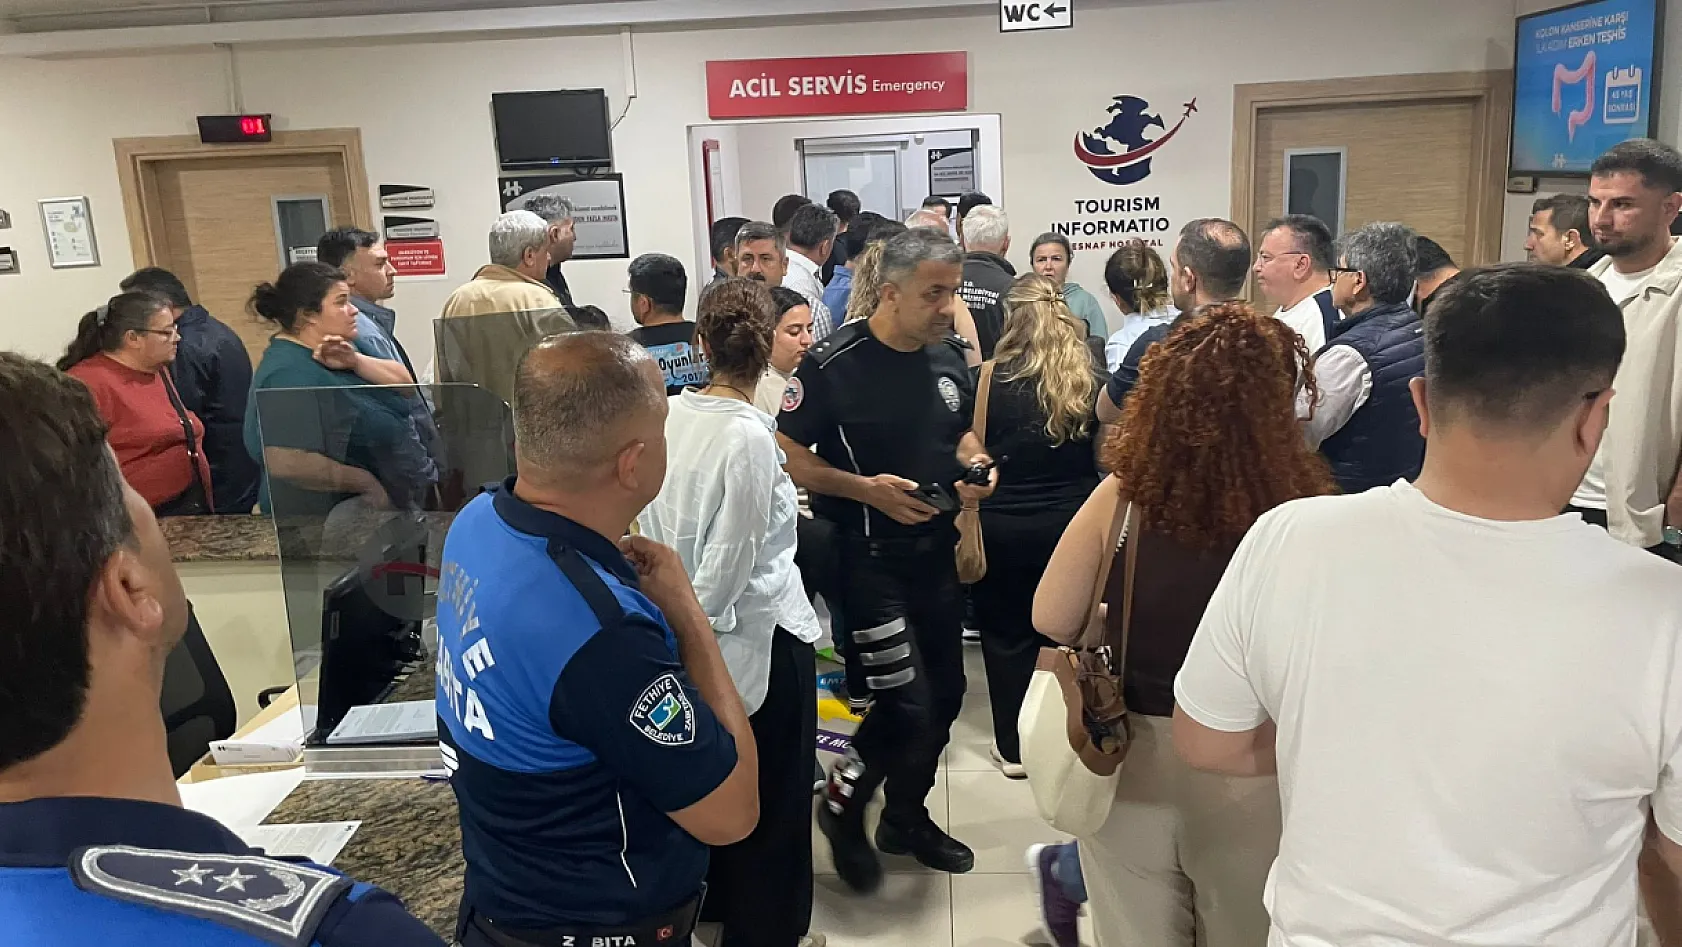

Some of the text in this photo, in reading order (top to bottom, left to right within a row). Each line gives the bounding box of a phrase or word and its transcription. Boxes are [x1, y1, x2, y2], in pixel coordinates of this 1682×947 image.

[1004, 3, 1040, 22] WC
[1568, 33, 1596, 48] ERKEN
[1596, 25, 1626, 44] TEŞHİS
[729, 69, 946, 98] ACİL SERVİS Emergency
[1074, 196, 1160, 214] TOURISM
[1051, 217, 1170, 236] INFORMATIO
[1072, 241, 1106, 250] ESNAF
[659, 350, 703, 379] Oyunlr
